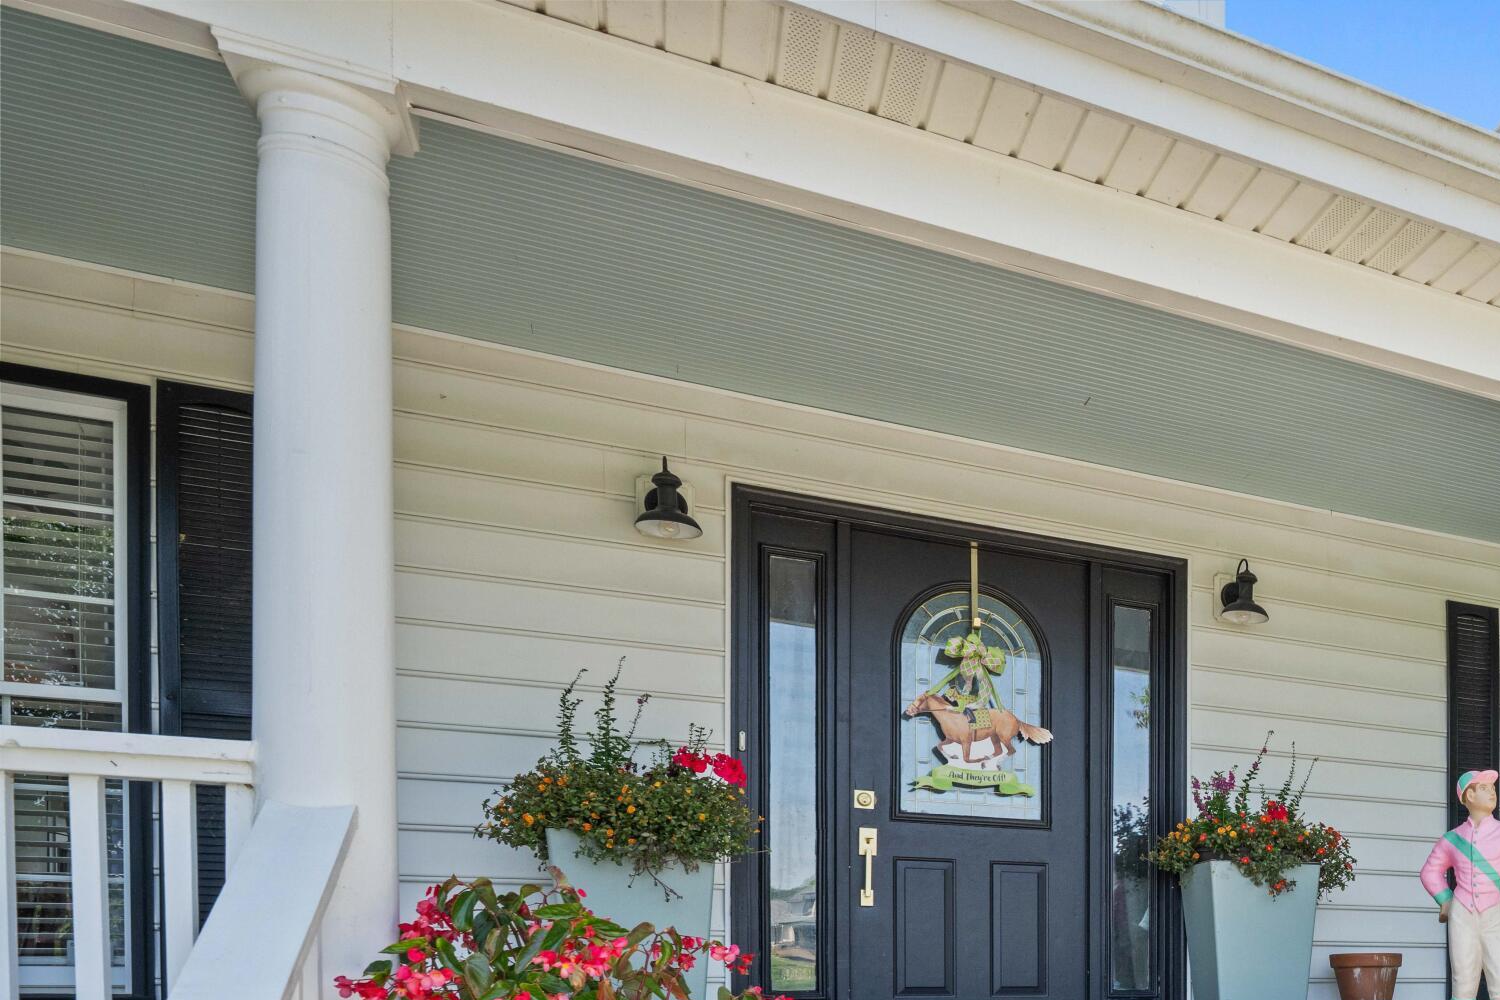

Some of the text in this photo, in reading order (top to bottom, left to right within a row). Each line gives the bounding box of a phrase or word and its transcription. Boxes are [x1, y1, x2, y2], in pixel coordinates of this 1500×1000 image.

[948, 771, 1006, 784] And They're Off!
